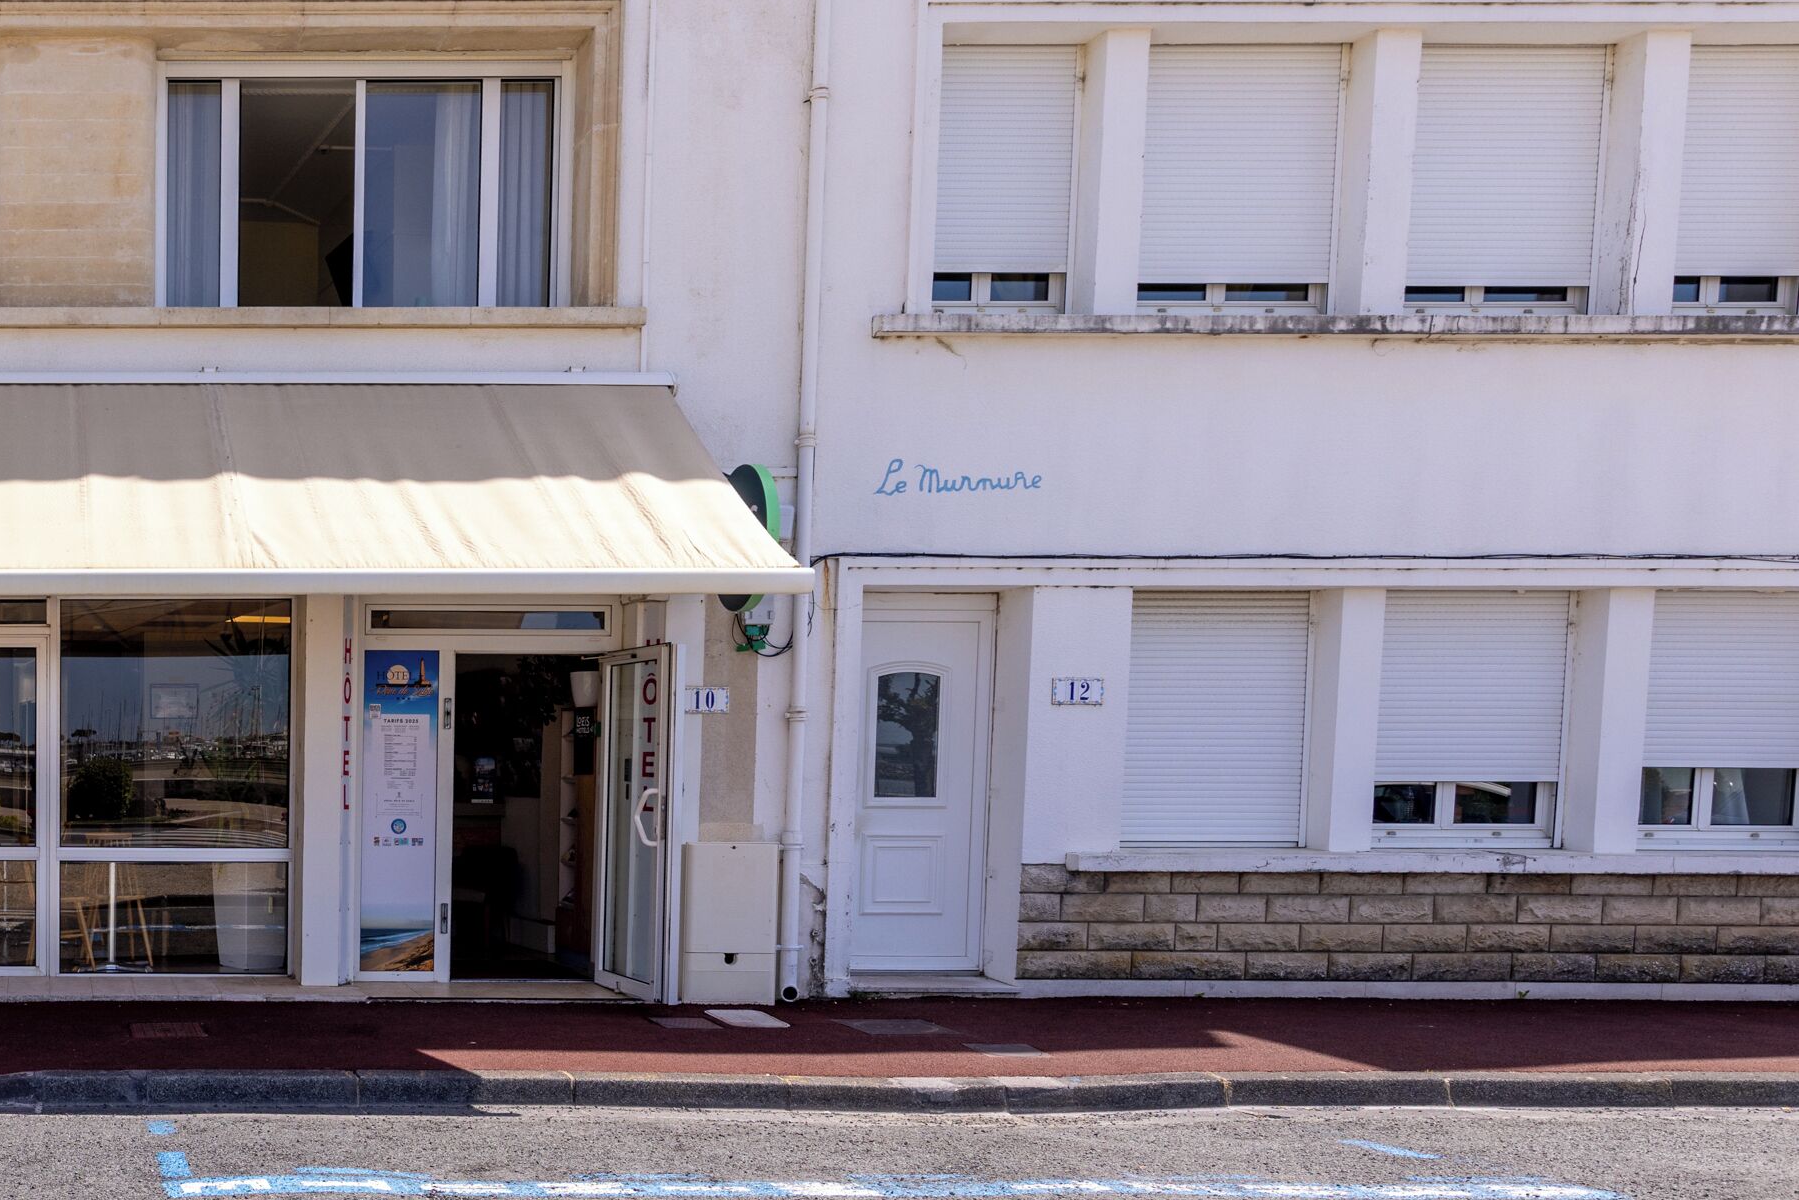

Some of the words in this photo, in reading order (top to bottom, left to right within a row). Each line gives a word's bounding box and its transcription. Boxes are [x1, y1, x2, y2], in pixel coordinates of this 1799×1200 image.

[874, 458, 907, 496] Le
[694, 690, 715, 710] 10
[1068, 681, 1090, 702] 12
[342, 637, 352, 810] HÔTEL
